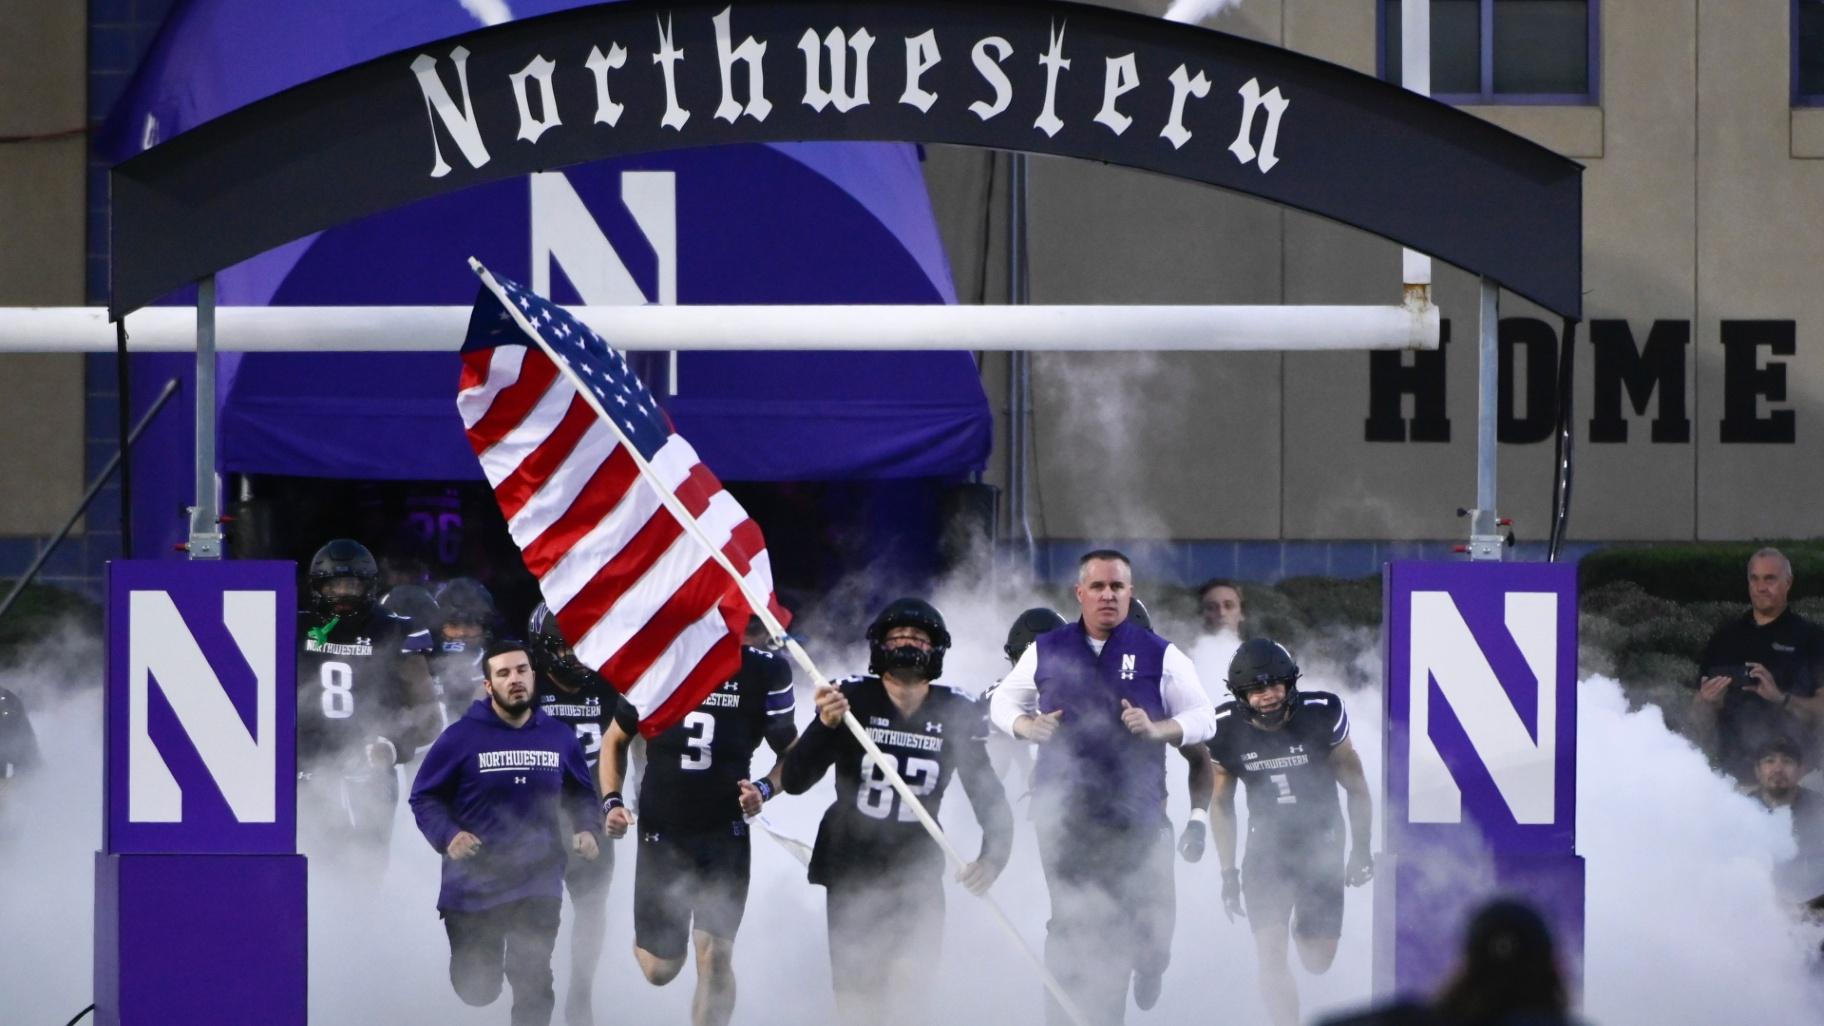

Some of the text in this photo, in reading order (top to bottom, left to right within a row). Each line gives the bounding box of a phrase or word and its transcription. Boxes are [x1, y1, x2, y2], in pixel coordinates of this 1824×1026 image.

[410, 4, 1290, 178] Northwestern
[1365, 317, 1796, 444] HOME
[321, 661, 354, 719] 8
[1122, 654, 1136, 670] N
[129, 590, 276, 823] N
[702, 693, 740, 708] ESTERN
[1408, 591, 1558, 825] N
[478, 750, 560, 768] NORTHWESTERN
[681, 711, 715, 770] 3
[1244, 754, 1309, 771] NORTHWESTERN
[857, 752, 940, 822] 82
[1270, 774, 1297, 804] 1
